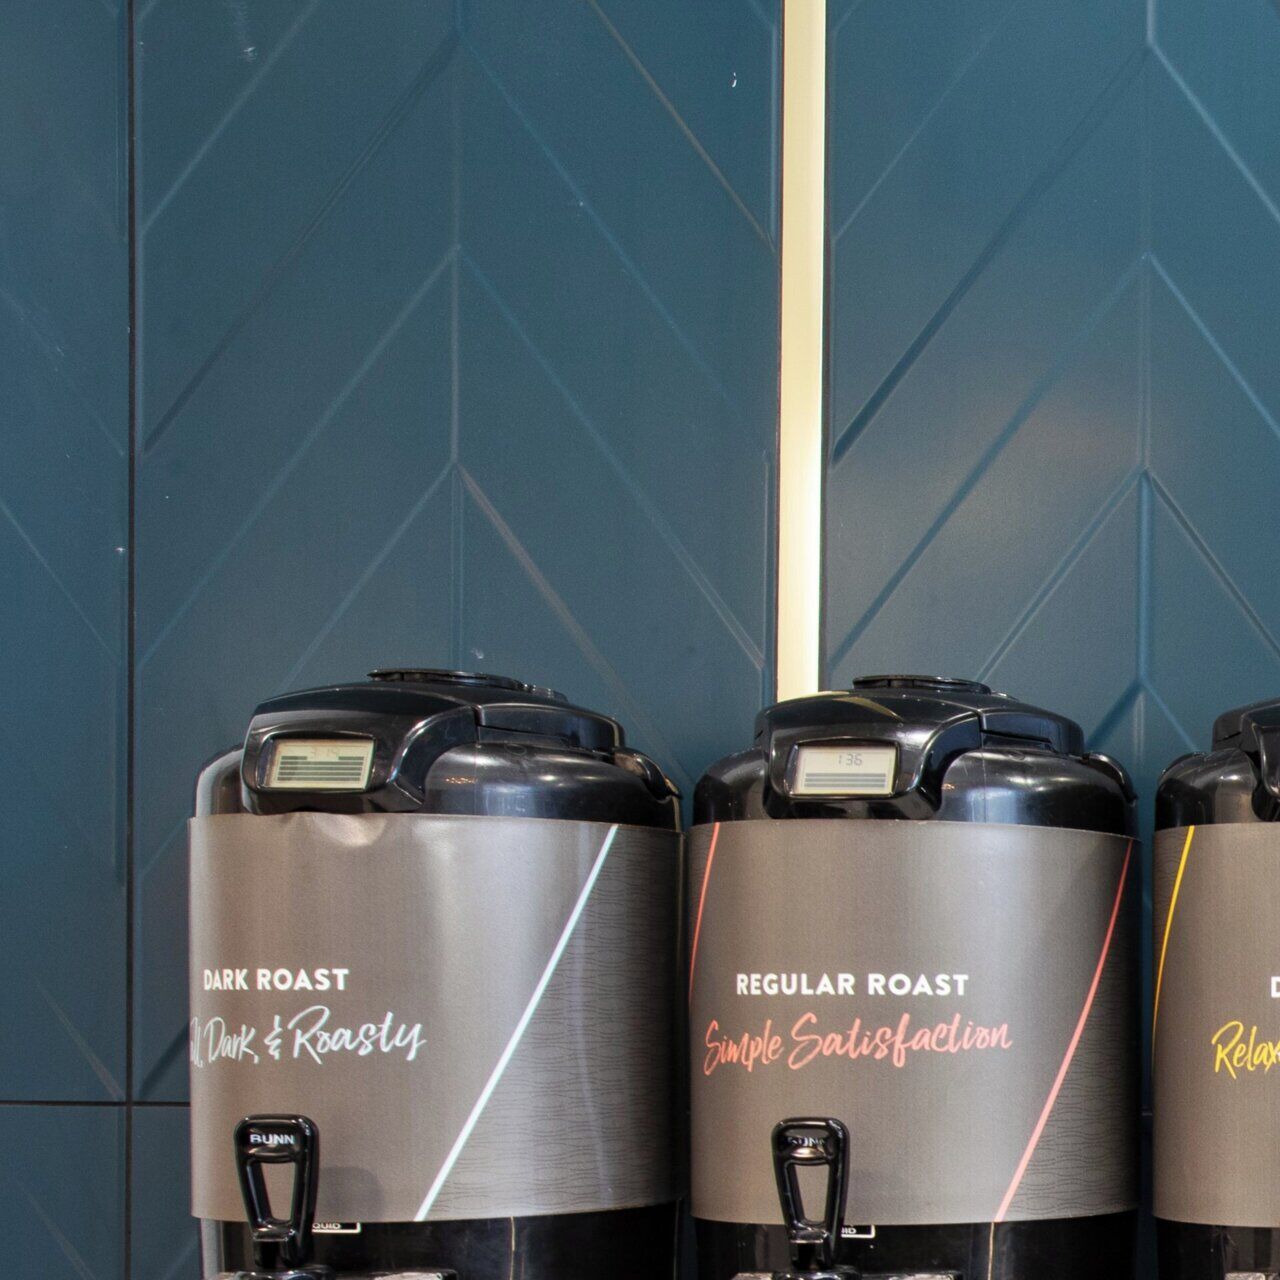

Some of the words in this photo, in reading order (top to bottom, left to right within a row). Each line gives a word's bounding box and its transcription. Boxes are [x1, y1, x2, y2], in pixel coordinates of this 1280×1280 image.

[203, 968, 249, 991] DARK
[256, 968, 350, 991] ROAST
[736, 973, 856, 995] REGULAR
[867, 973, 970, 996] ROAST
[264, 1014, 283, 1060] &
[287, 1005, 427, 1065] Roasty
[703, 1019, 784, 1076] Simple
[787, 1011, 1013, 1071] Satisfaction
[250, 1133, 296, 1145] BUNN
